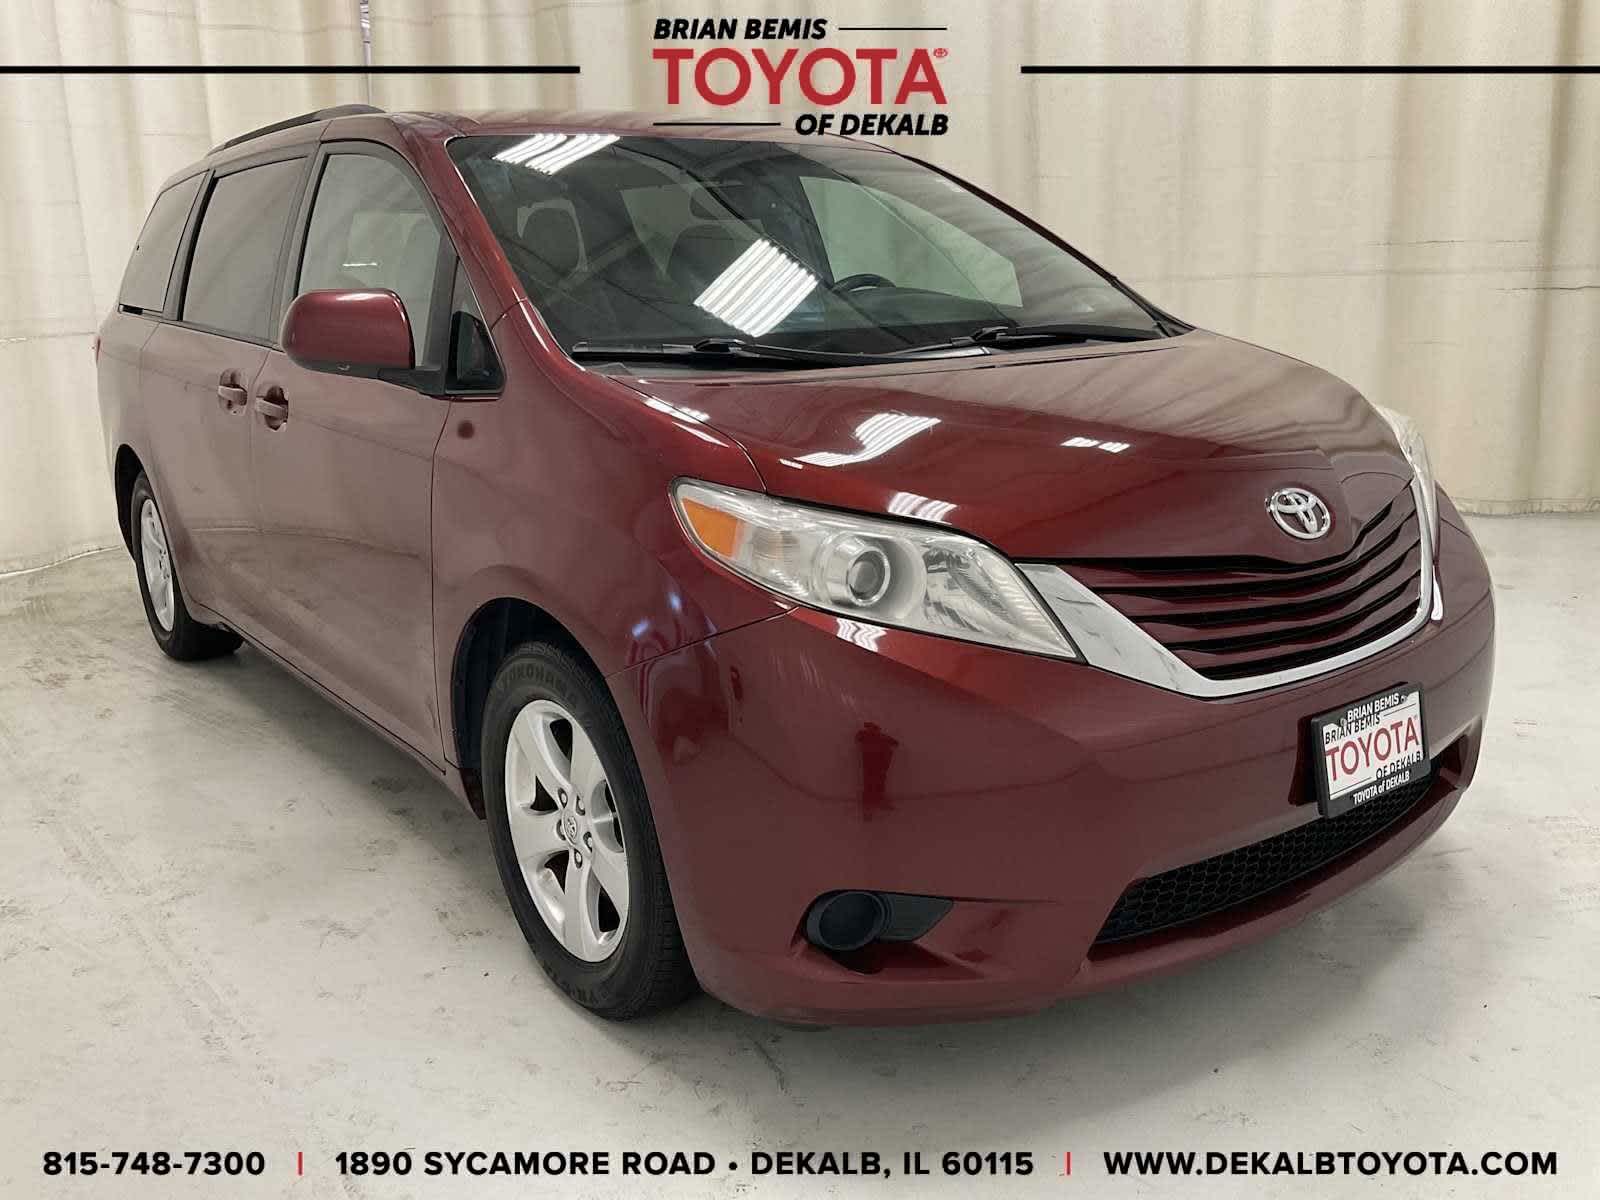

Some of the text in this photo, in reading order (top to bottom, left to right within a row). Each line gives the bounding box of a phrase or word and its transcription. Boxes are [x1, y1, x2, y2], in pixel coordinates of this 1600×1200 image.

[1347, 693, 1400, 723] BRIAN BEMIS
[1325, 714, 1380, 745] BRIAN BEMIS
[1325, 717, 1419, 781] TOYOTA
[1376, 751, 1421, 780] OF DEKALB
[1353, 771, 1410, 805] TOYOTA of DEKALB
